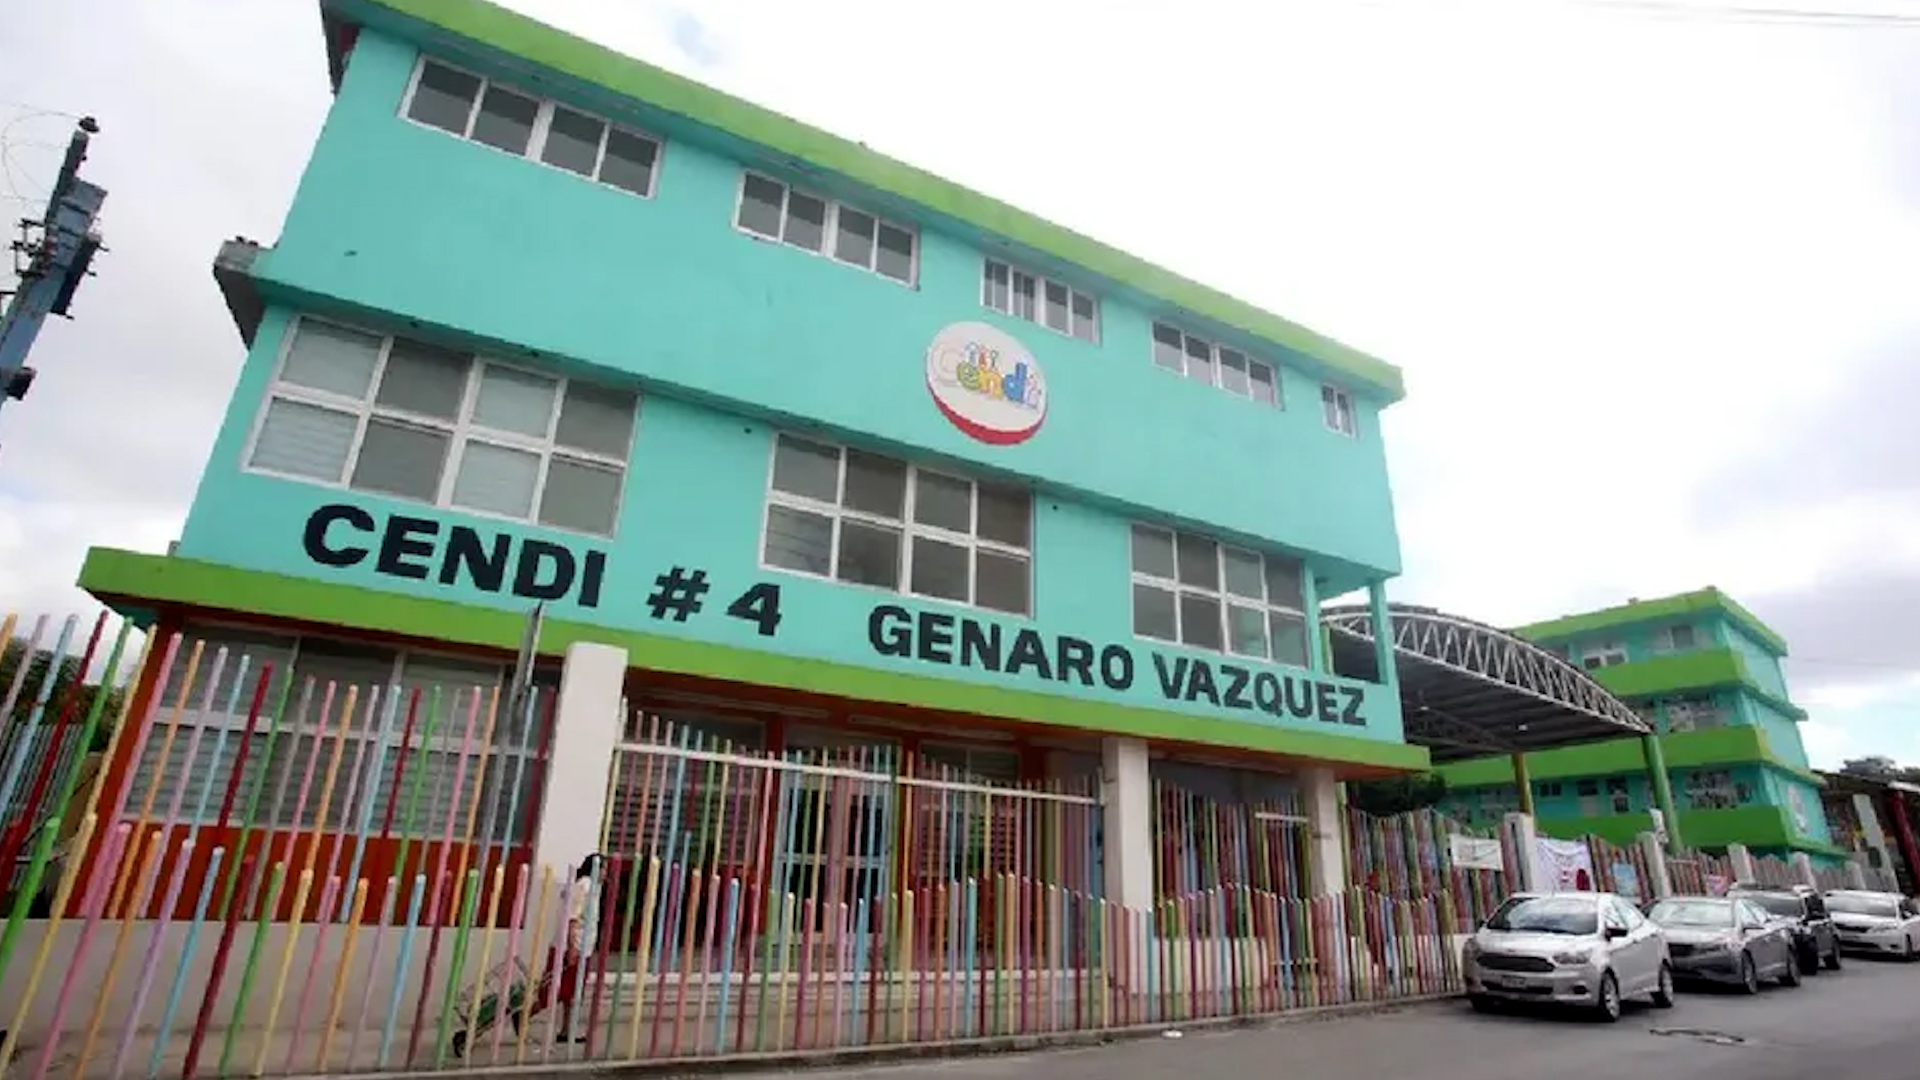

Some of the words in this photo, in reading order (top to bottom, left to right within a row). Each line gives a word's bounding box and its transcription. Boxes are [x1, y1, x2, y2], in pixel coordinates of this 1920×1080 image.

[302, 503, 607, 608] CENDI
[646, 566, 710, 623] #
[726, 582, 782, 637] 4
[868, 604, 1134, 691] GENARO
[1151, 651, 1367, 726] VAZQUEZ
